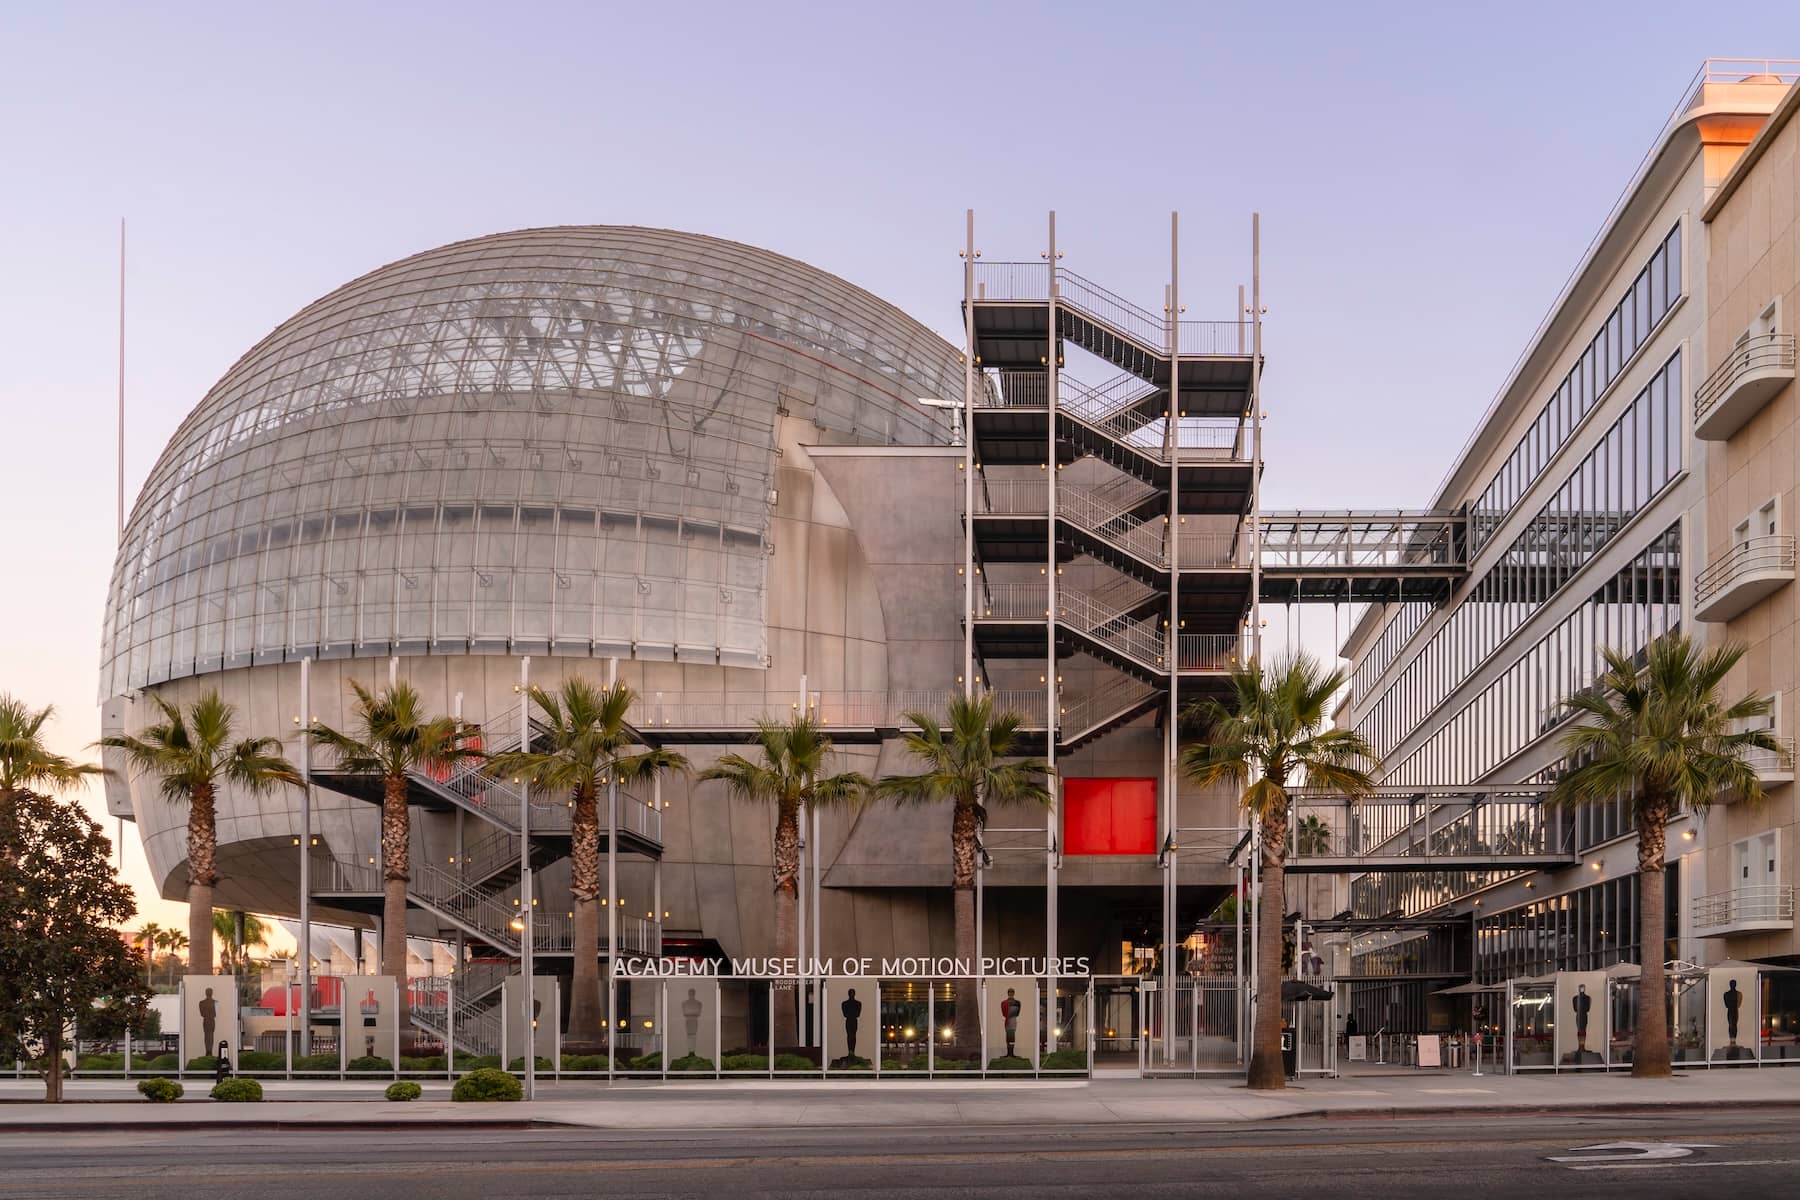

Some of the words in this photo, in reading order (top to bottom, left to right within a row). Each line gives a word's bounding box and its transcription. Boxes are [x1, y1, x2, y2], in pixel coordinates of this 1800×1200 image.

[612, 957, 723, 976] ACADEMY
[732, 957, 833, 976] MUSEUM
[843, 957, 873, 976] OF
[882, 957, 970, 976] MOTION
[981, 957, 1090, 976] PICTURES
